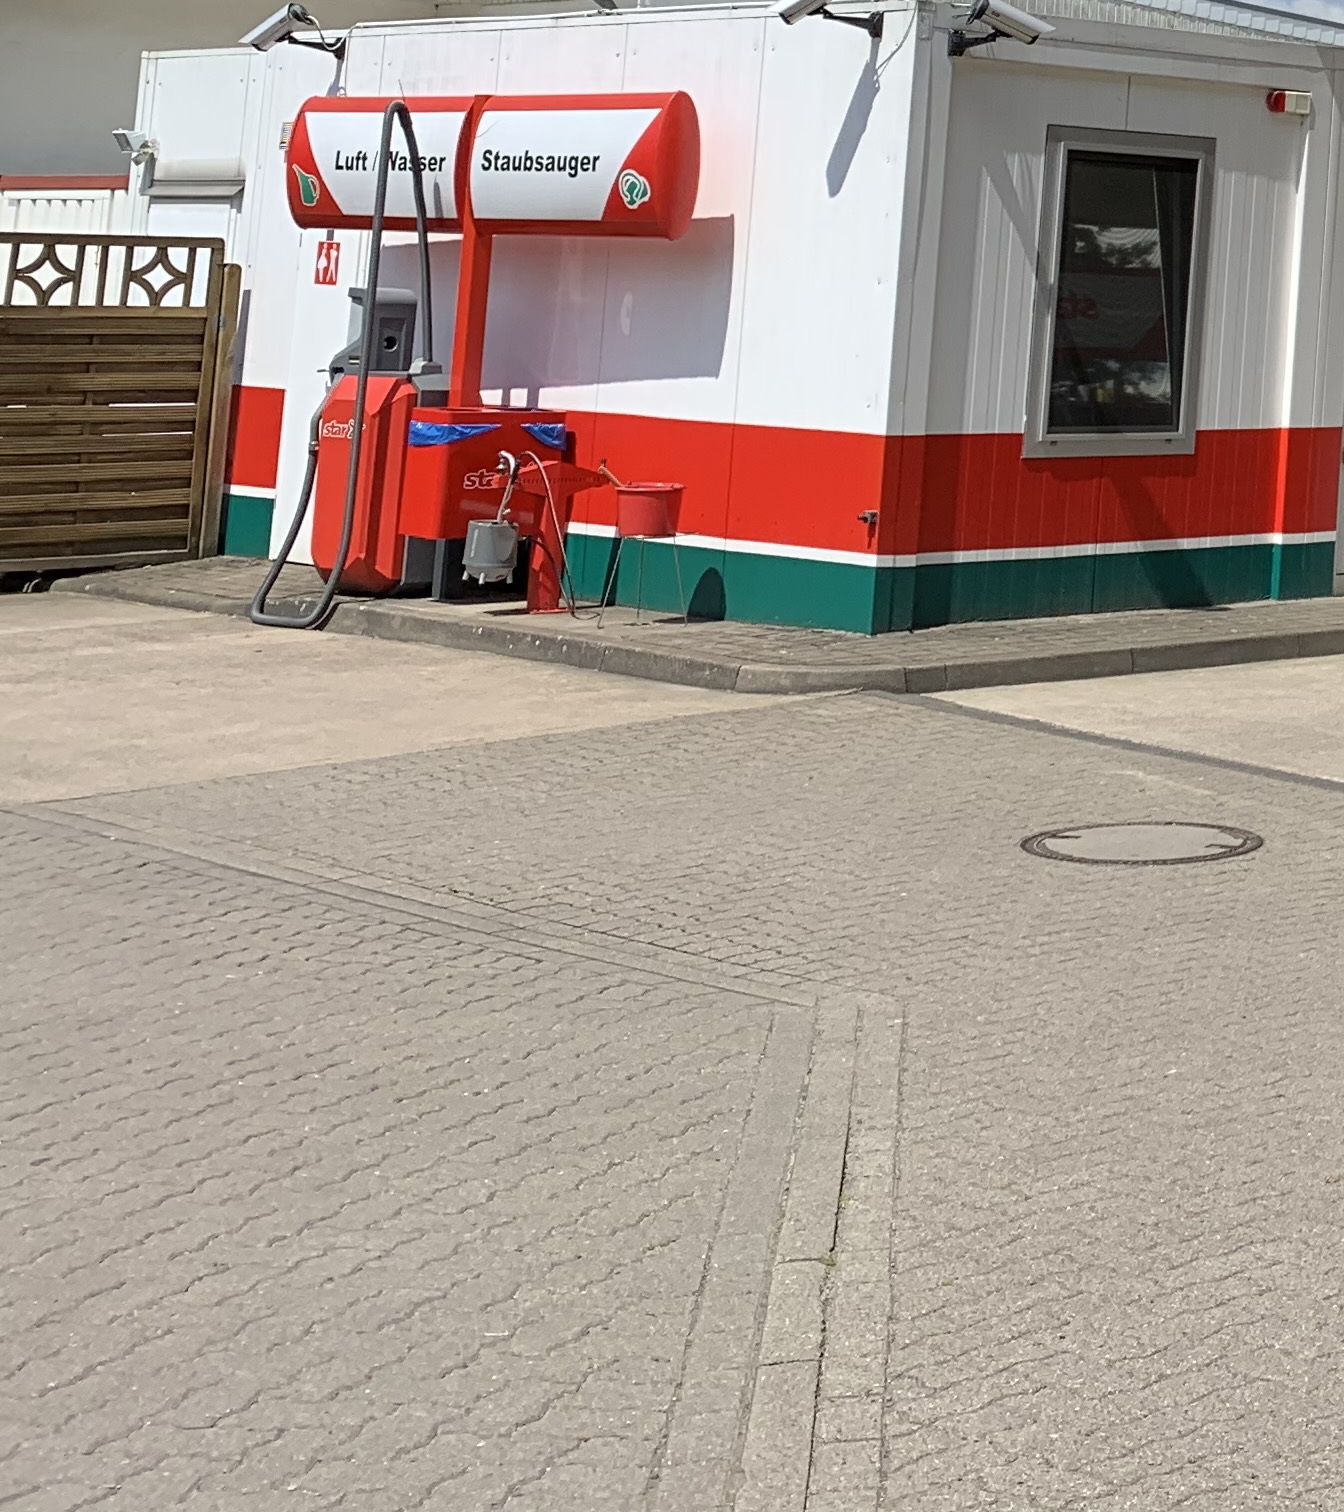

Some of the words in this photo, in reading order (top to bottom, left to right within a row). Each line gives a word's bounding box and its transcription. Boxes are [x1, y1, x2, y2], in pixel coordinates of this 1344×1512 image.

[334, 149, 368, 172] Luft
[481, 149, 601, 178] Staubsauger
[322, 419, 349, 438] star
